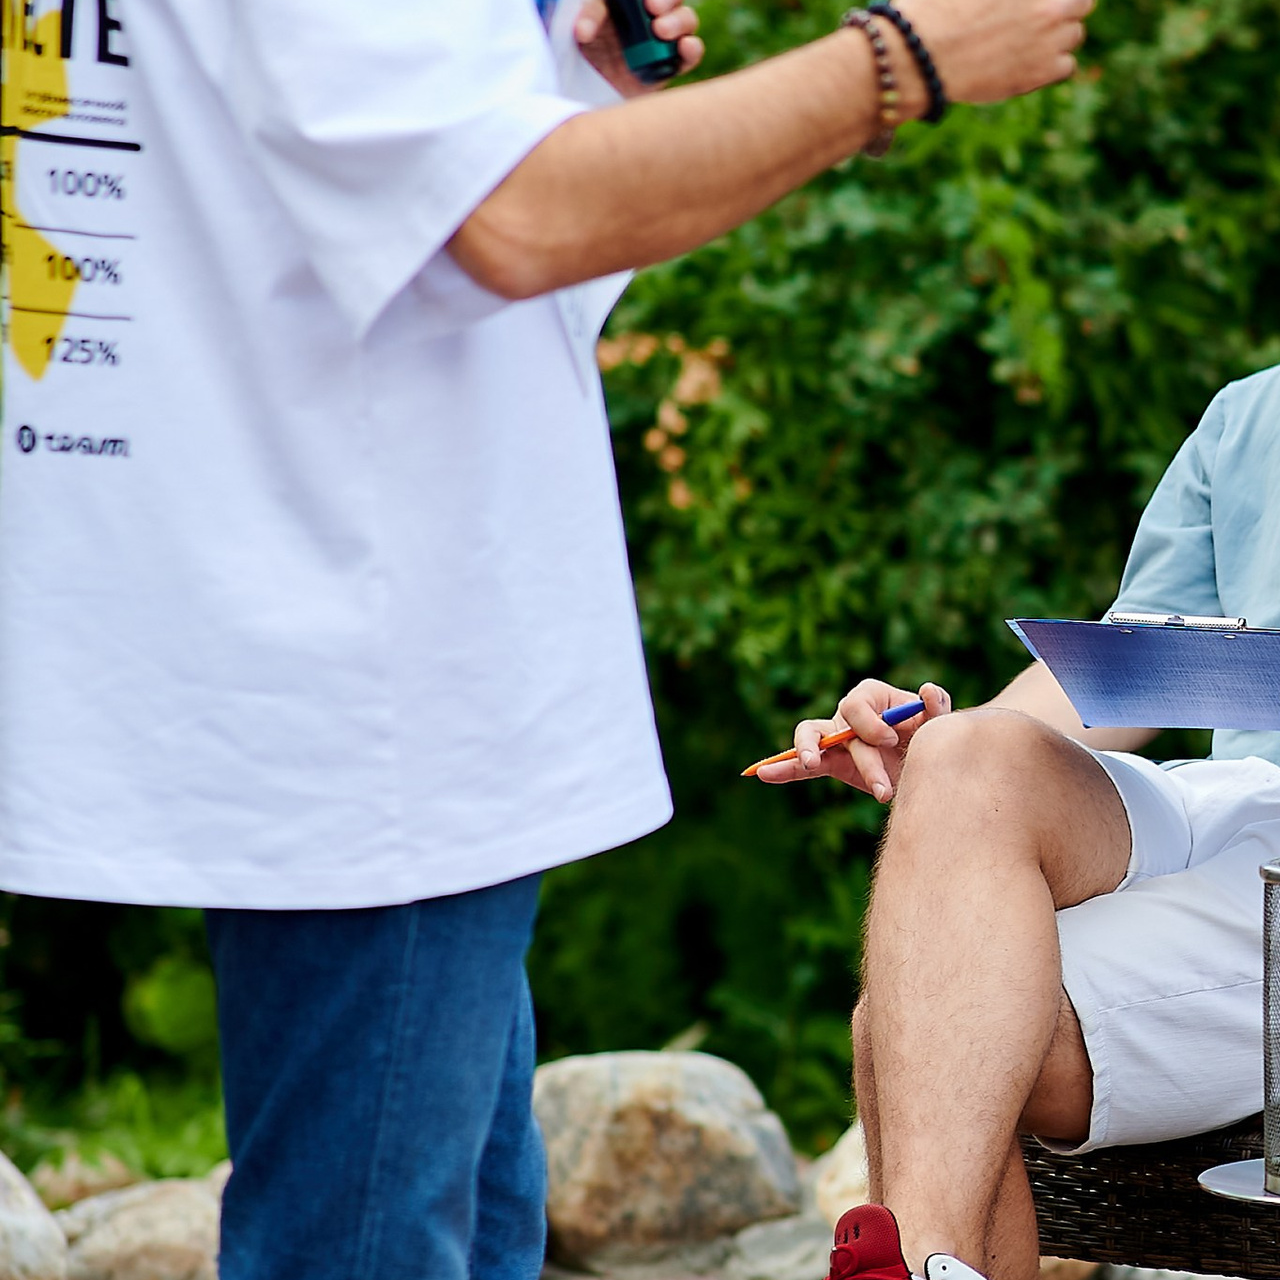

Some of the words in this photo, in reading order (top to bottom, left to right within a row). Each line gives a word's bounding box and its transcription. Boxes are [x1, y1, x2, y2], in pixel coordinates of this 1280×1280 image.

[48, 169, 125, 200] 100%
[45, 254, 122, 284] 100%
[44, 336, 120, 366] 125%
